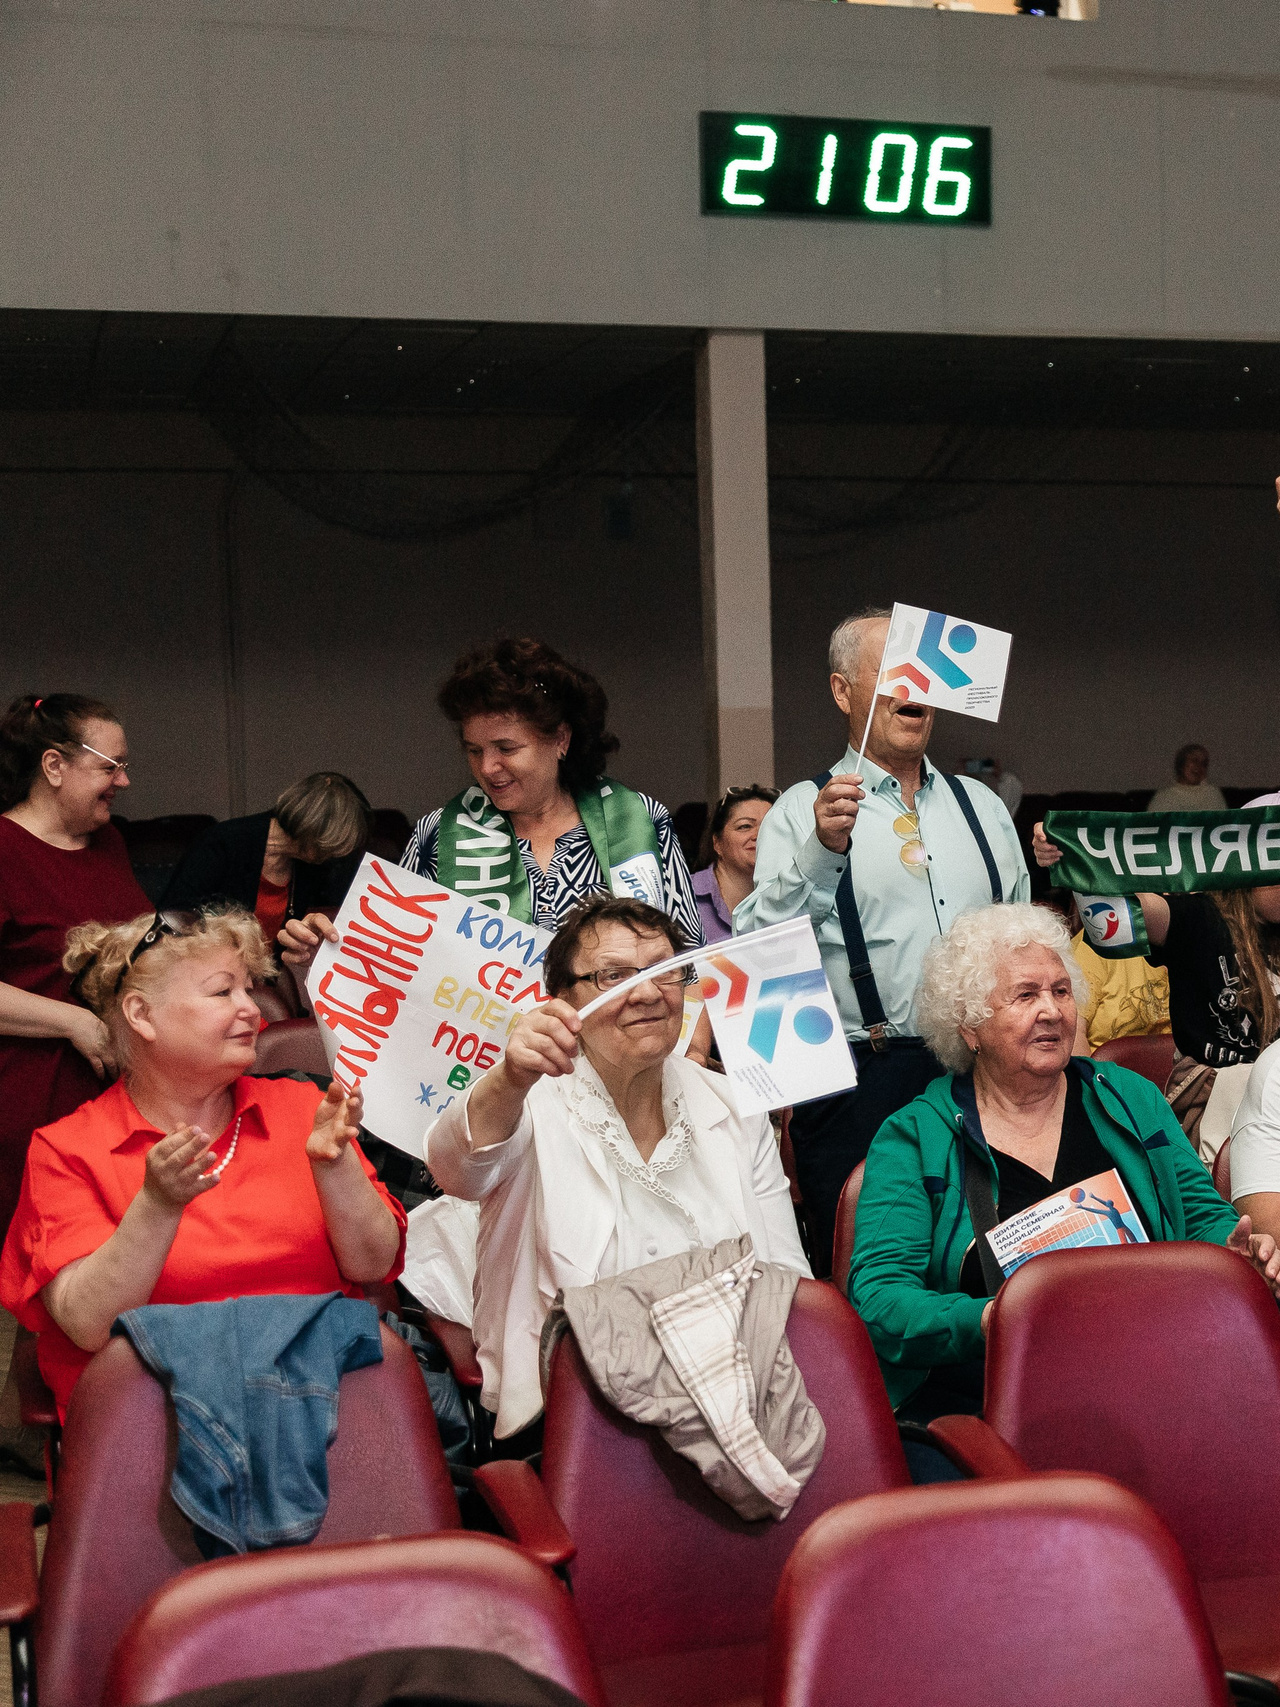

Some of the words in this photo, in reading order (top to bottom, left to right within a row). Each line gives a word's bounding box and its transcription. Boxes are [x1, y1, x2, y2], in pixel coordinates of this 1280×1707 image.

[993, 1210, 1037, 1241] ДВИЖЕНИЕ
[995, 1229, 1020, 1246] НАША
[1021, 1204, 1066, 1231] СЕМЕЙНАЯ
[998, 1224, 1042, 1252] ТРАДИЦИЯ
